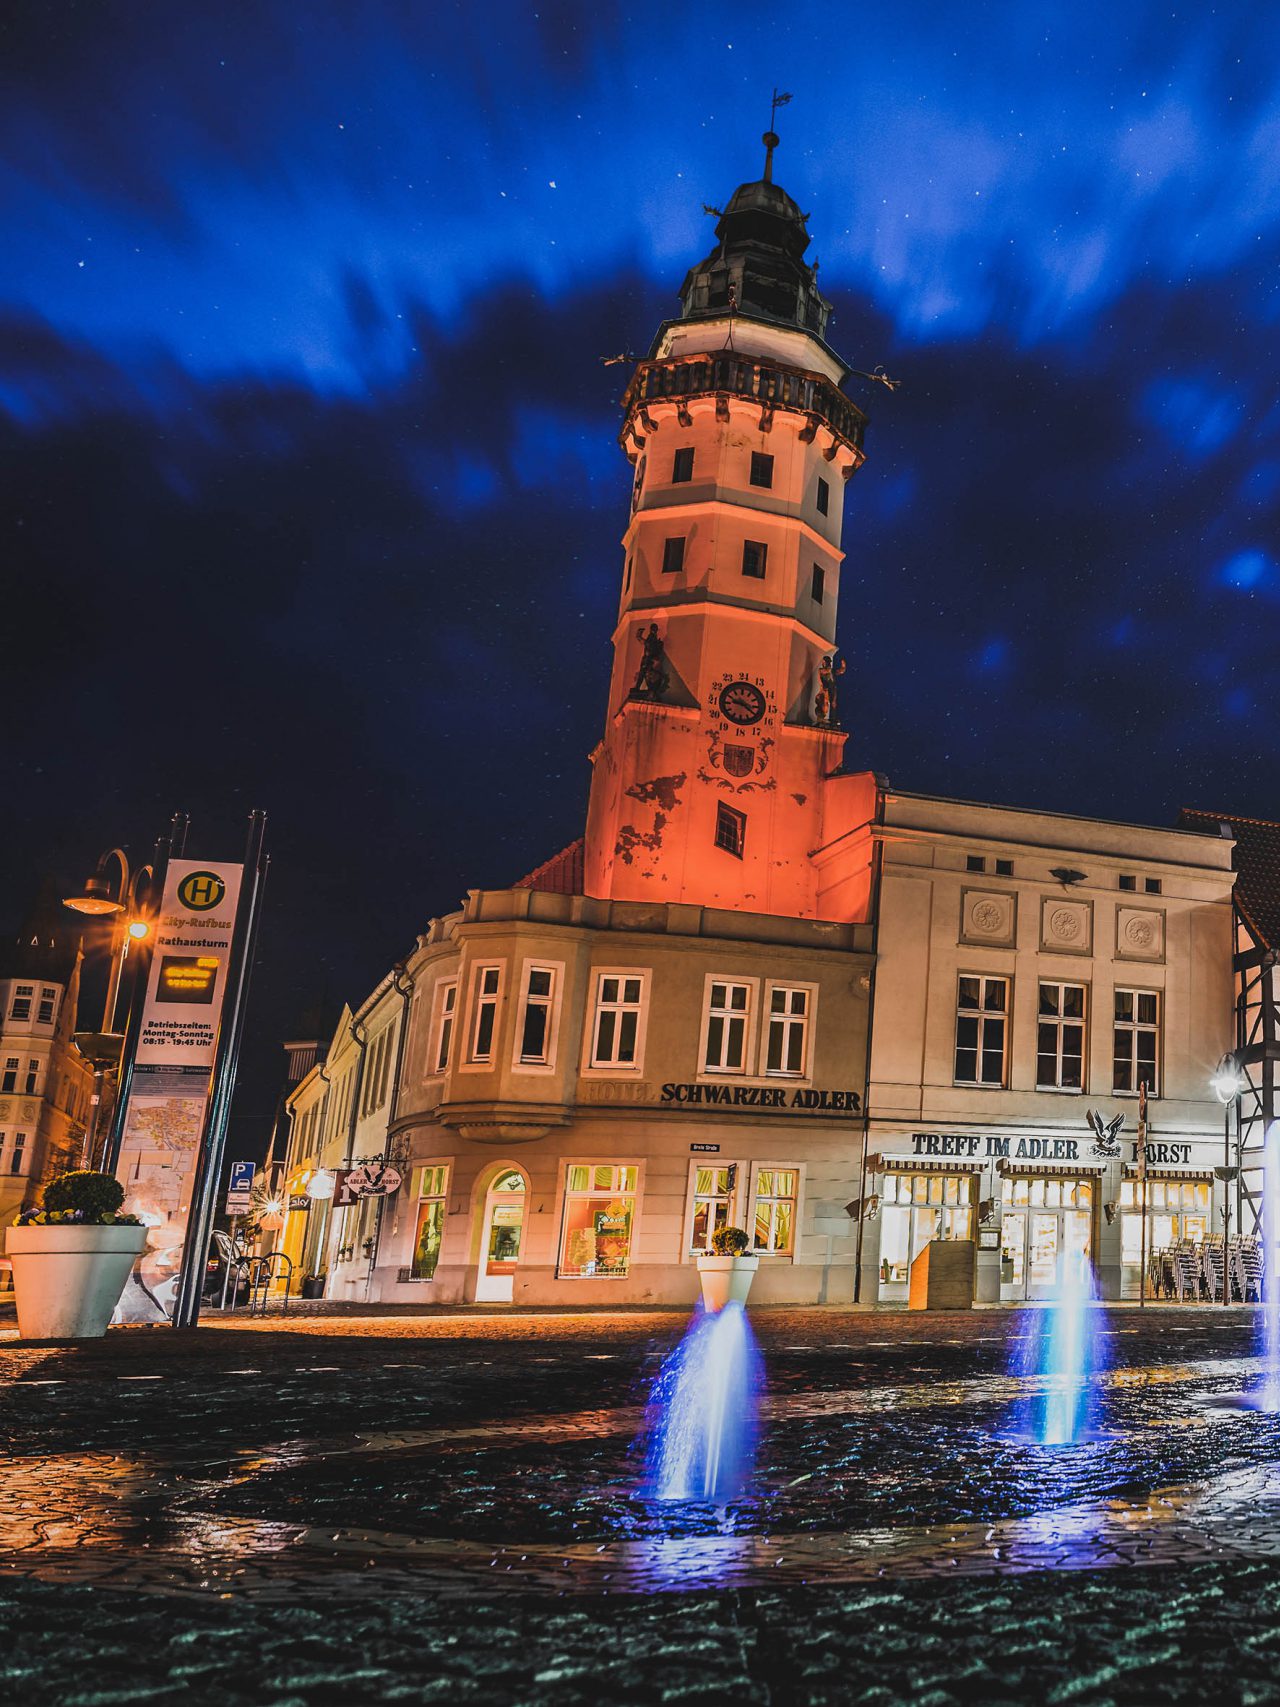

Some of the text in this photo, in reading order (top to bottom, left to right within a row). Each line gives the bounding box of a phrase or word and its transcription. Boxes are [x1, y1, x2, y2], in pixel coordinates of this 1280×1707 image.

[755, 677, 765, 686] 13
[708, 693, 718, 705] 21
[765, 690, 775, 699] 14
[768, 704, 778, 713] 15
[709, 710, 720, 718] 20
[764, 717, 774, 726] 16
[720, 722, 729, 731] 19
[736, 728, 746, 737] 18
[752, 727, 761, 736] 17
[191, 879, 213, 902] H
[162, 916, 232, 928] City-Rufbus
[157, 936, 229, 948] Rathausturm
[148, 1021, 212, 1030] Betriebszeiten:
[142, 1030, 214, 1040] Montag-Sonntag
[660, 1083, 787, 1108] SCHWARZER
[790, 1089, 862, 1112] ADLER
[912, 1134, 981, 1156] TREFF
[985, 1136, 1010, 1158] IM
[1015, 1138, 1080, 1160] ADLER
[235, 1164, 246, 1176] P
